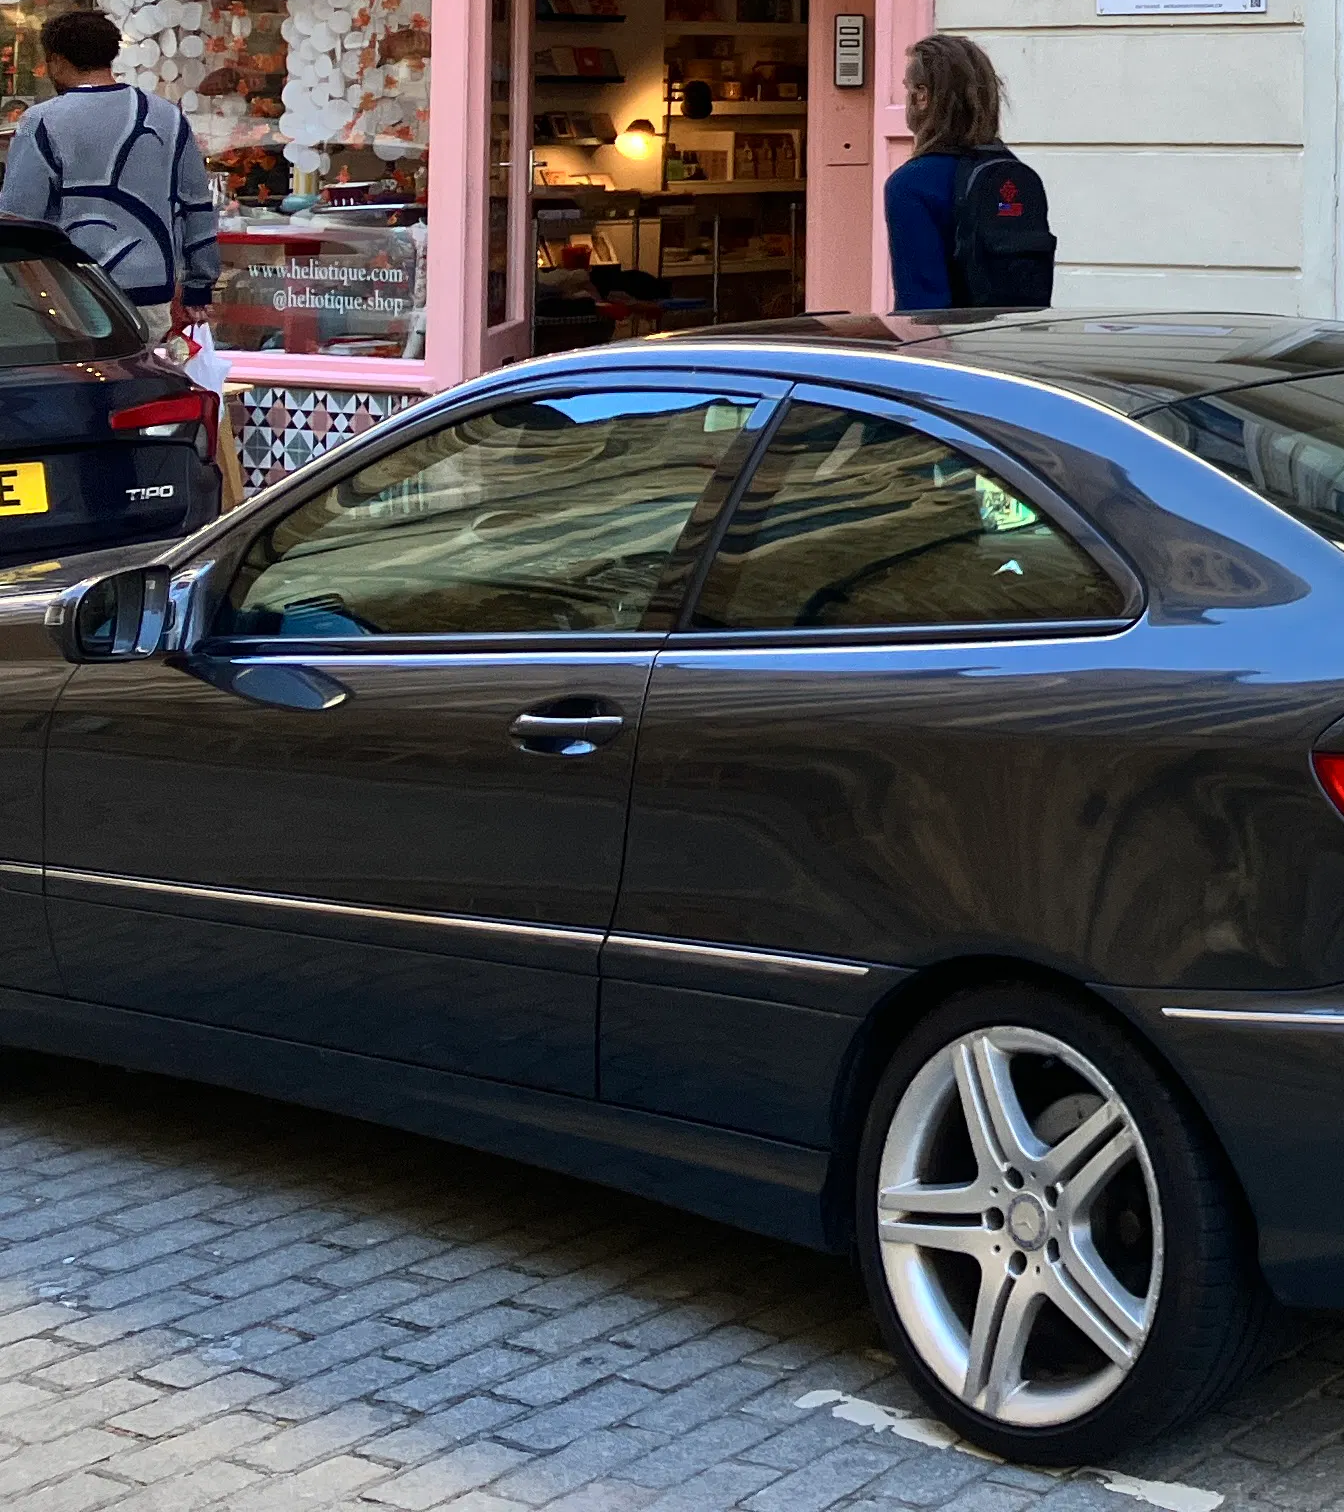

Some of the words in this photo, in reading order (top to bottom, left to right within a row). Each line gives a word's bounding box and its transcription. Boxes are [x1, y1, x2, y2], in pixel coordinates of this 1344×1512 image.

[248, 257, 403, 286] www.heliotique.com
[273, 286, 403, 317] @heliotique.shop
[126, 485, 174, 501] TIPO
